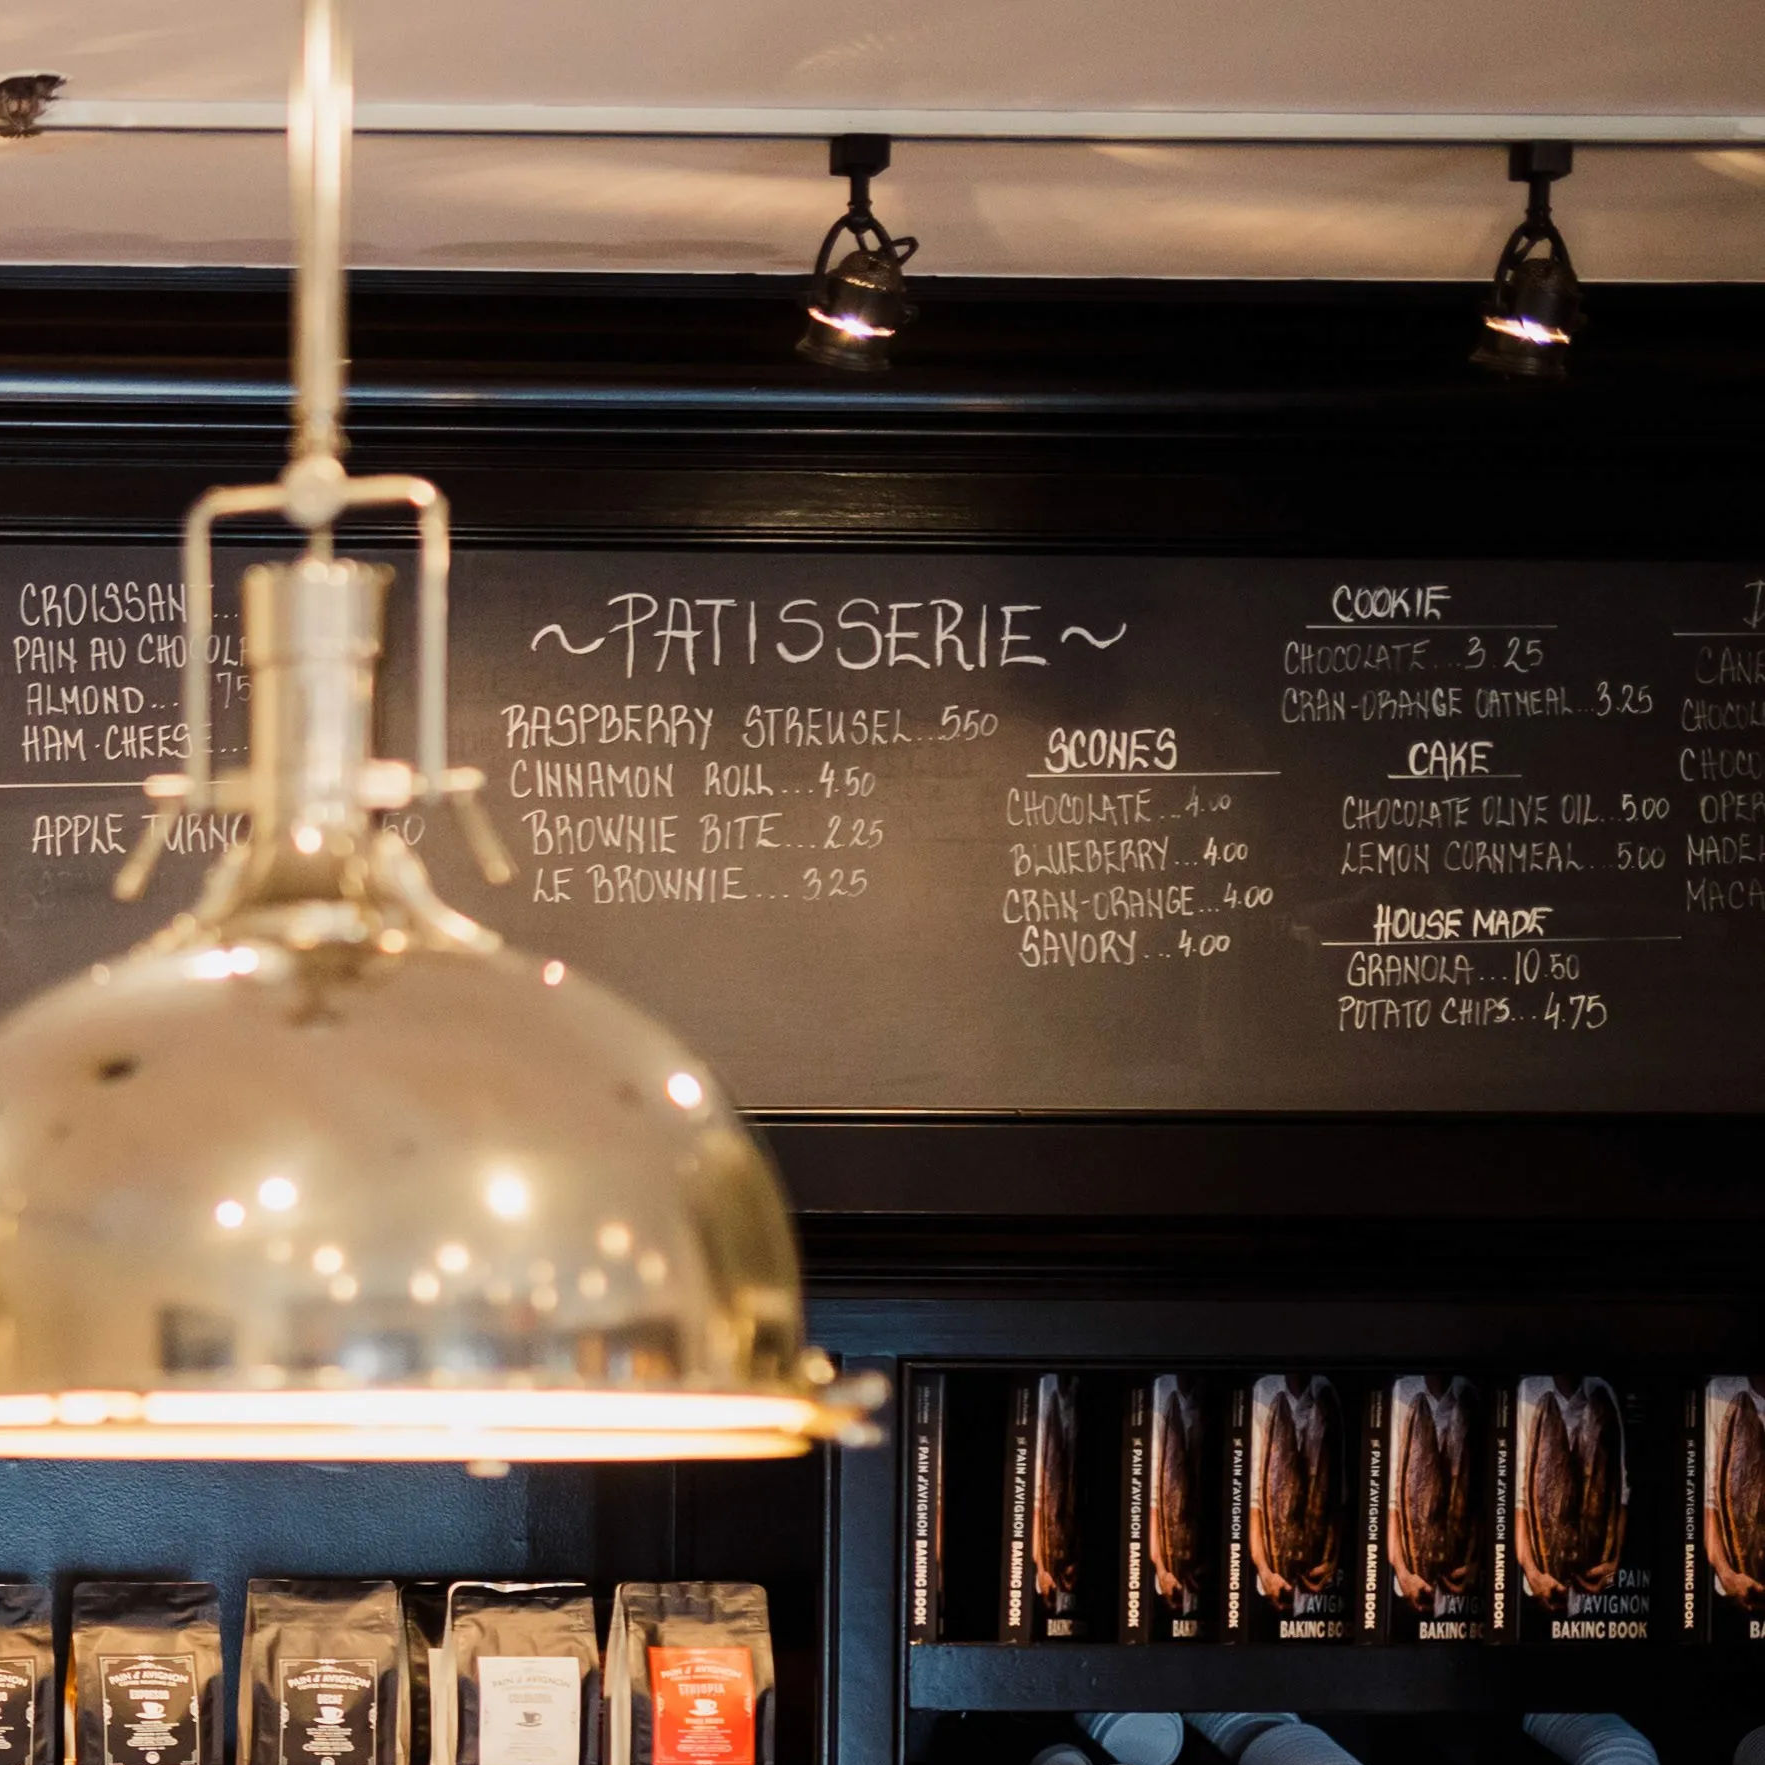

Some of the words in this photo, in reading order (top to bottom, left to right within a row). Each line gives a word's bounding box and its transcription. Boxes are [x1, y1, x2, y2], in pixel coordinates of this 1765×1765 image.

[1332, 585, 1452, 623] COOKIE
[608, 592, 1049, 679] PATISSERIE
[13, 637, 78, 675] PAIN
[91, 636, 126, 673] AU
[1280, 687, 1463, 724] CRAN-ORANGE
[1595, 680, 1654, 717] 3.25
[22, 724, 87, 763] HAM
[501, 704, 714, 751] RASPBERRY
[1044, 728, 1178, 775] SCONES
[1408, 740, 1494, 778] CAKE
[510, 763, 673, 799] CINNAMON
[818, 763, 876, 799] 4.50
[1341, 793, 1470, 831] CHOCOLATE
[1483, 793, 1548, 828] OLIVE
[1622, 792, 1670, 823] 5.00
[31, 813, 127, 857] APPLE
[521, 811, 678, 857] BROWNIE
[1202, 839, 1249, 867] 4.00
[1341, 840, 1430, 876] LEMON
[1617, 841, 1666, 870] 5.00
[532, 867, 574, 904] LE
[1222, 884, 1274, 914] 4.00
[1374, 904, 1463, 944] HOUSE
[1473, 906, 1554, 939] MADE
[1178, 932, 1230, 958] 4.00
[1513, 951, 1581, 984] 10.50
[1338, 996, 1430, 1031] POTATO
[1543, 994, 1608, 1031] 4.75
[1228, 1594, 1240, 1629] BOOK
[1364, 1593, 1376, 1629] BOOK
[1493, 1591, 1504, 1629] BOOK
[1608, 1621, 1648, 1640] BOOK
